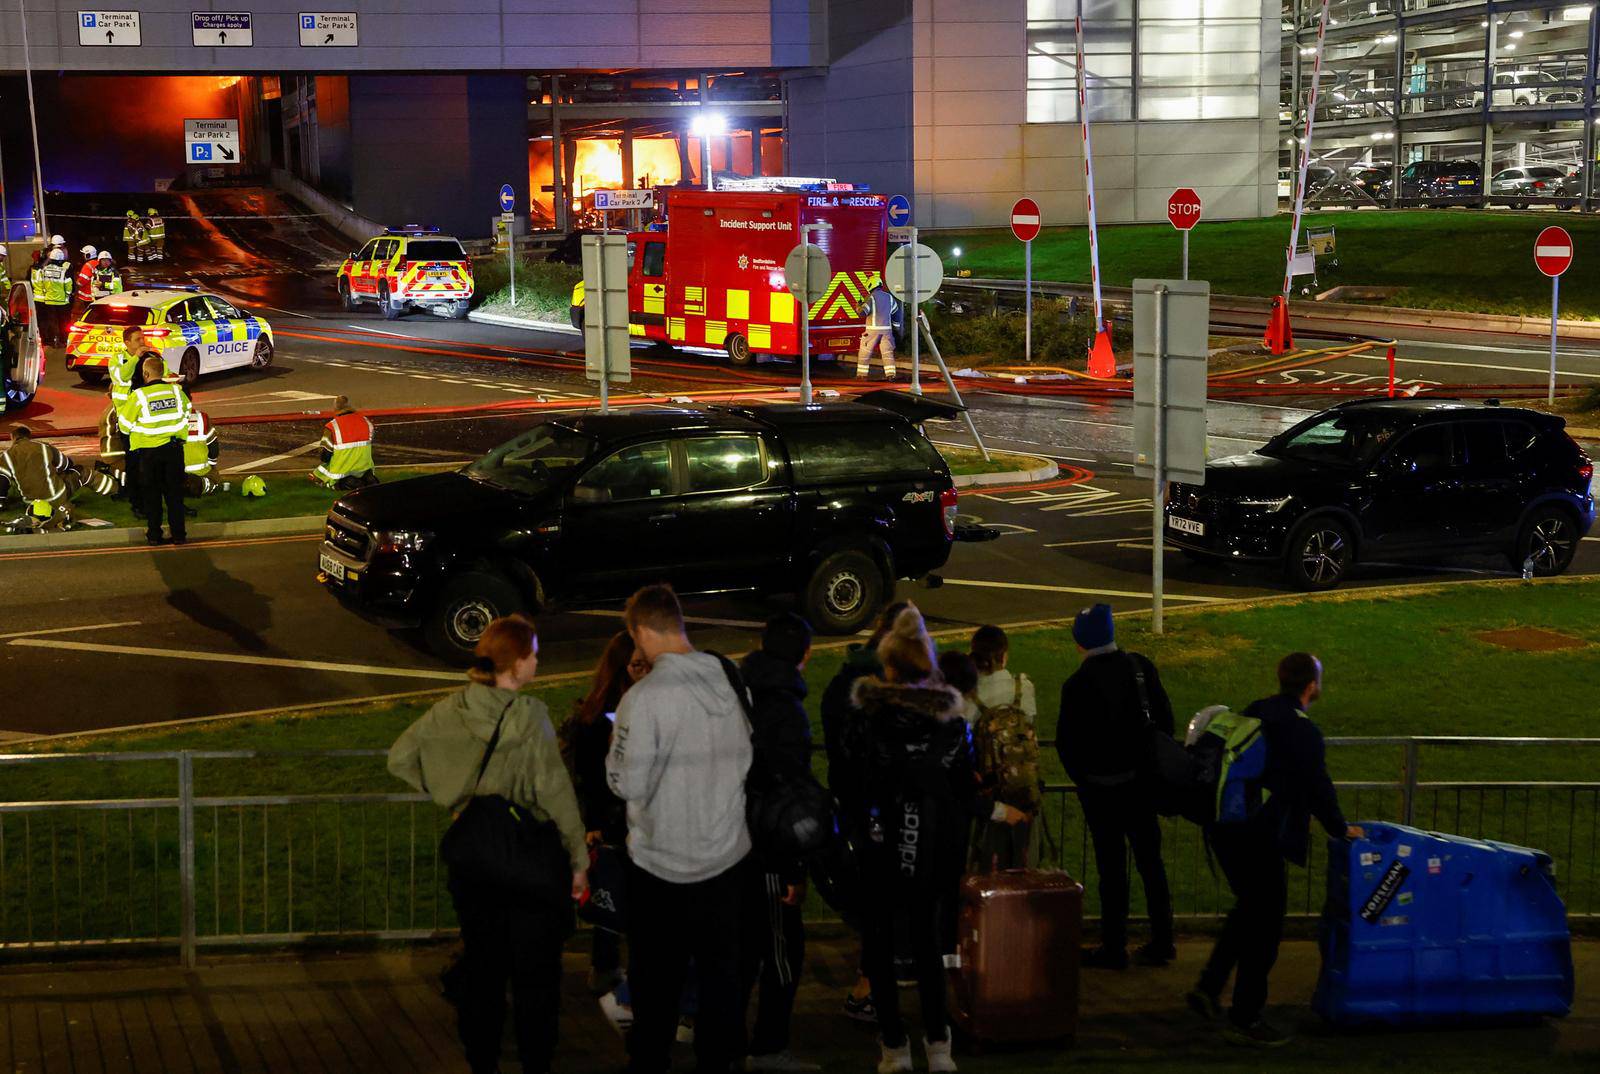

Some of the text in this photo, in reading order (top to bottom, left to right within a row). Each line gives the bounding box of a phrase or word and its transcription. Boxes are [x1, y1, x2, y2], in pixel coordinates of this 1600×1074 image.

[193, 131, 205, 139] Car
[807, 197, 880, 207] FIRE & RESCUE
[1169, 203, 1200, 215] STOP
[720, 219, 792, 231] Incident Support Unit
[89, 335, 122, 343] POLIC
[208, 341, 249, 355] POLICE
[150, 398, 176, 410] POLICE
[1171, 516, 1187, 529] YR72
[898, 801, 920, 878] adidas
